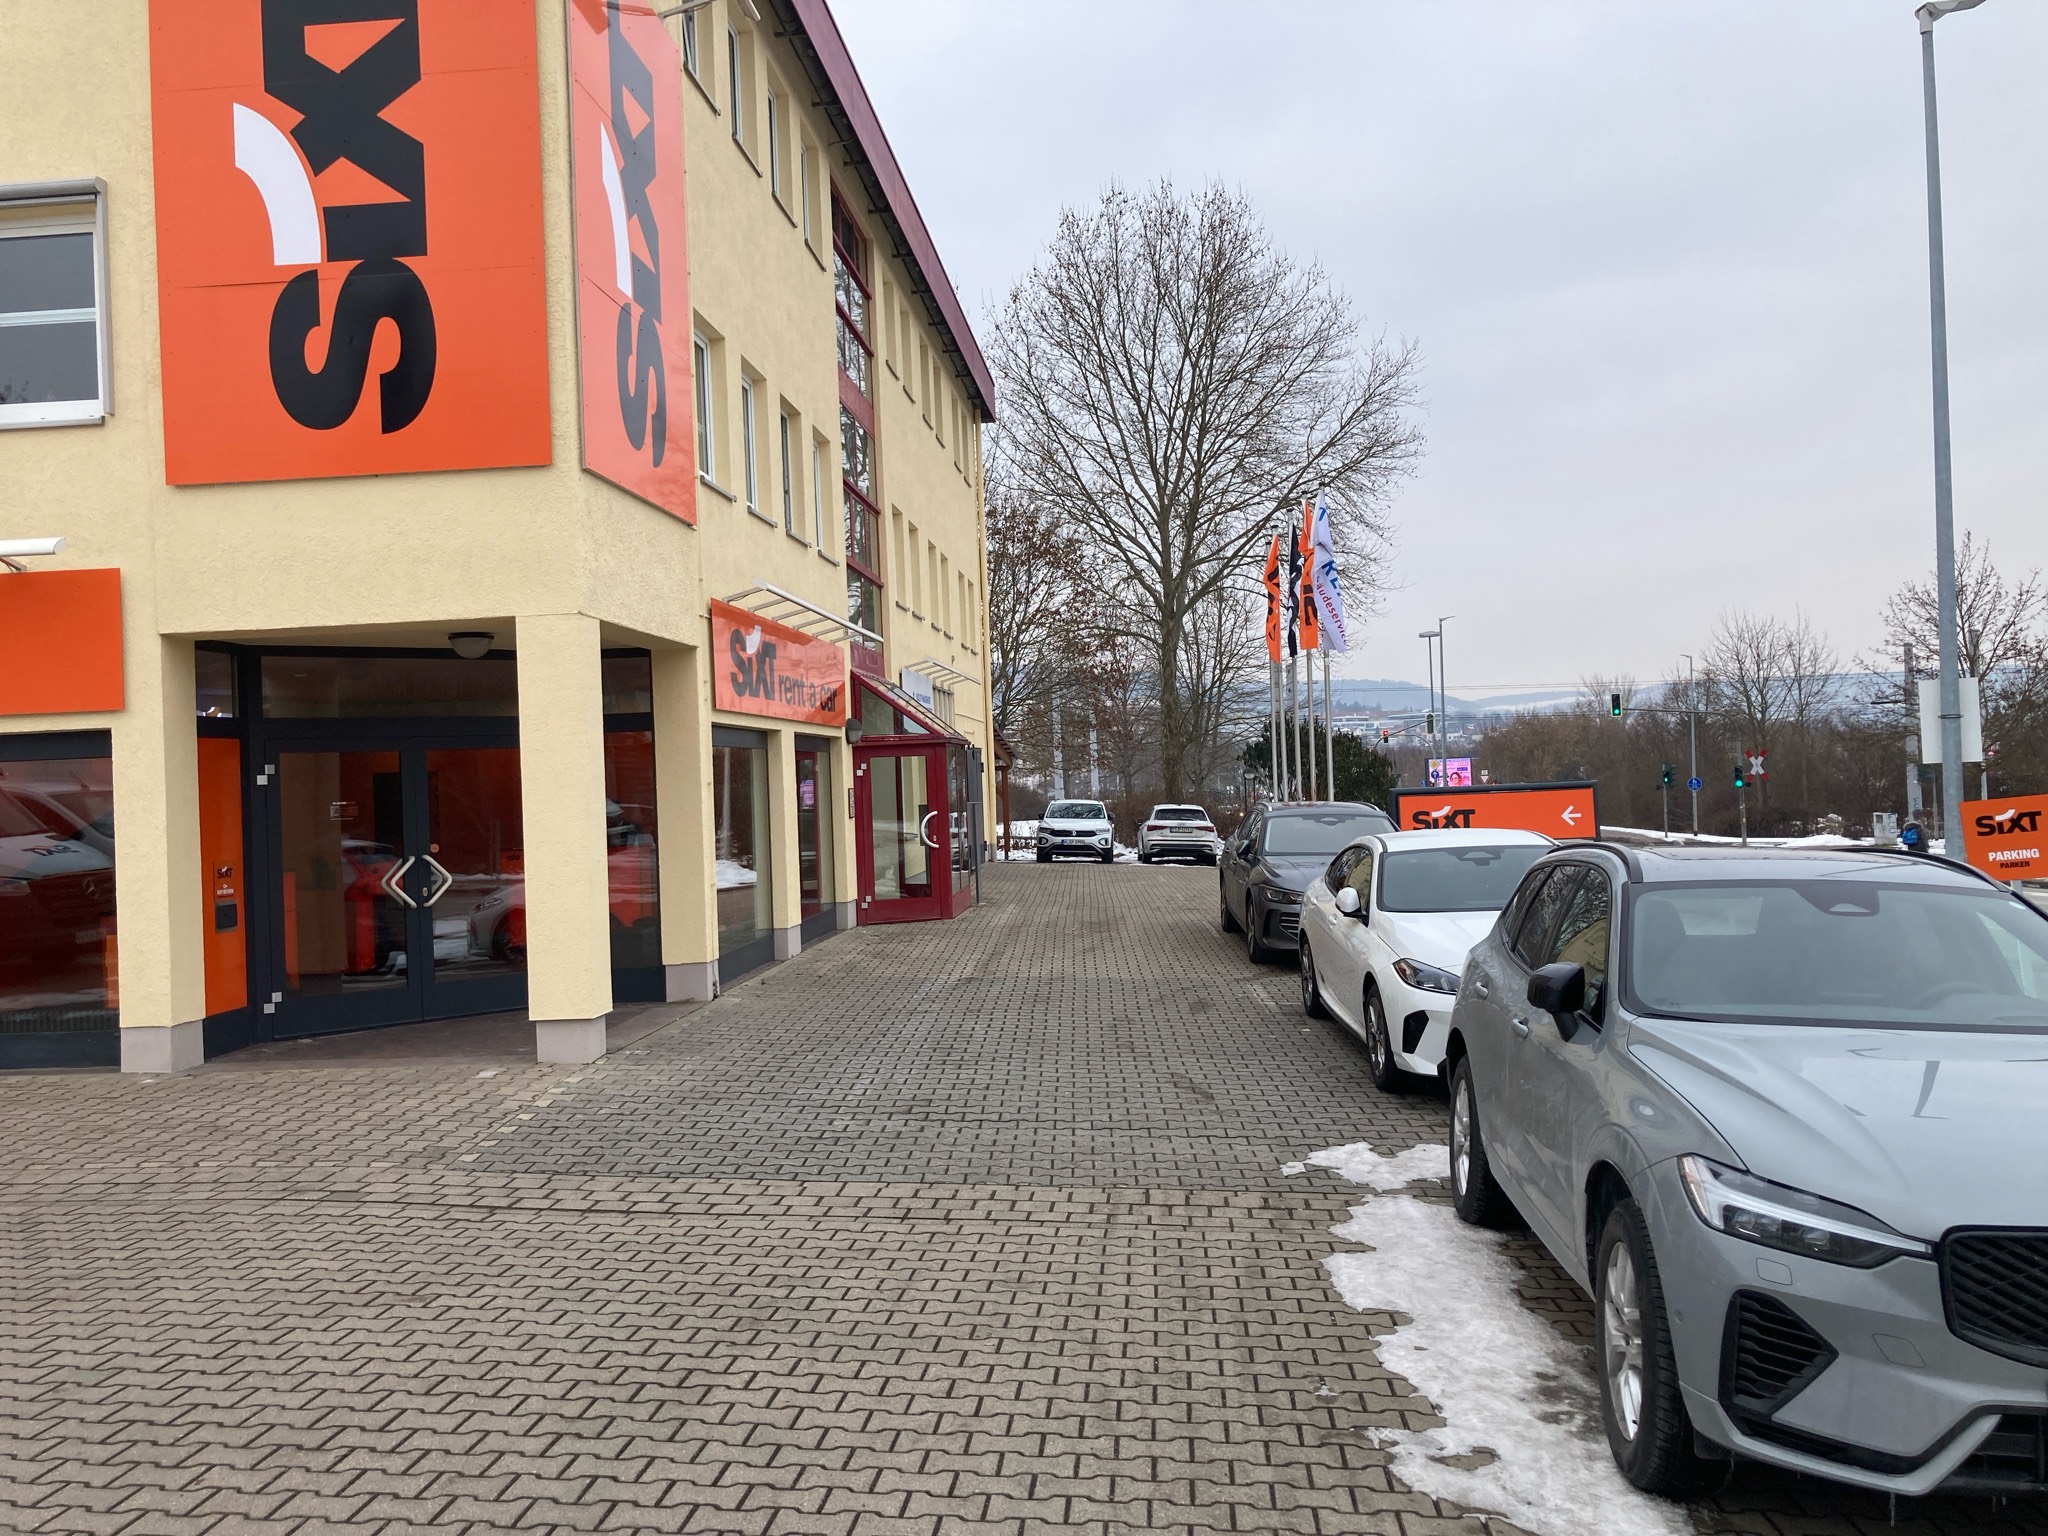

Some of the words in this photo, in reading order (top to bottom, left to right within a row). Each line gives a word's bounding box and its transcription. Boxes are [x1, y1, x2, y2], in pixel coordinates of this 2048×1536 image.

[730, 624, 776, 701] SIXT
[778, 673, 806, 708] rent
[809, 682, 816, 709] a
[820, 686, 837, 713] car
[1412, 805, 1475, 830] SIXT
[1975, 808, 2042, 837] SIXT
[1988, 848, 2040, 861] PARKING
[1999, 861, 2030, 869] PARKEN
